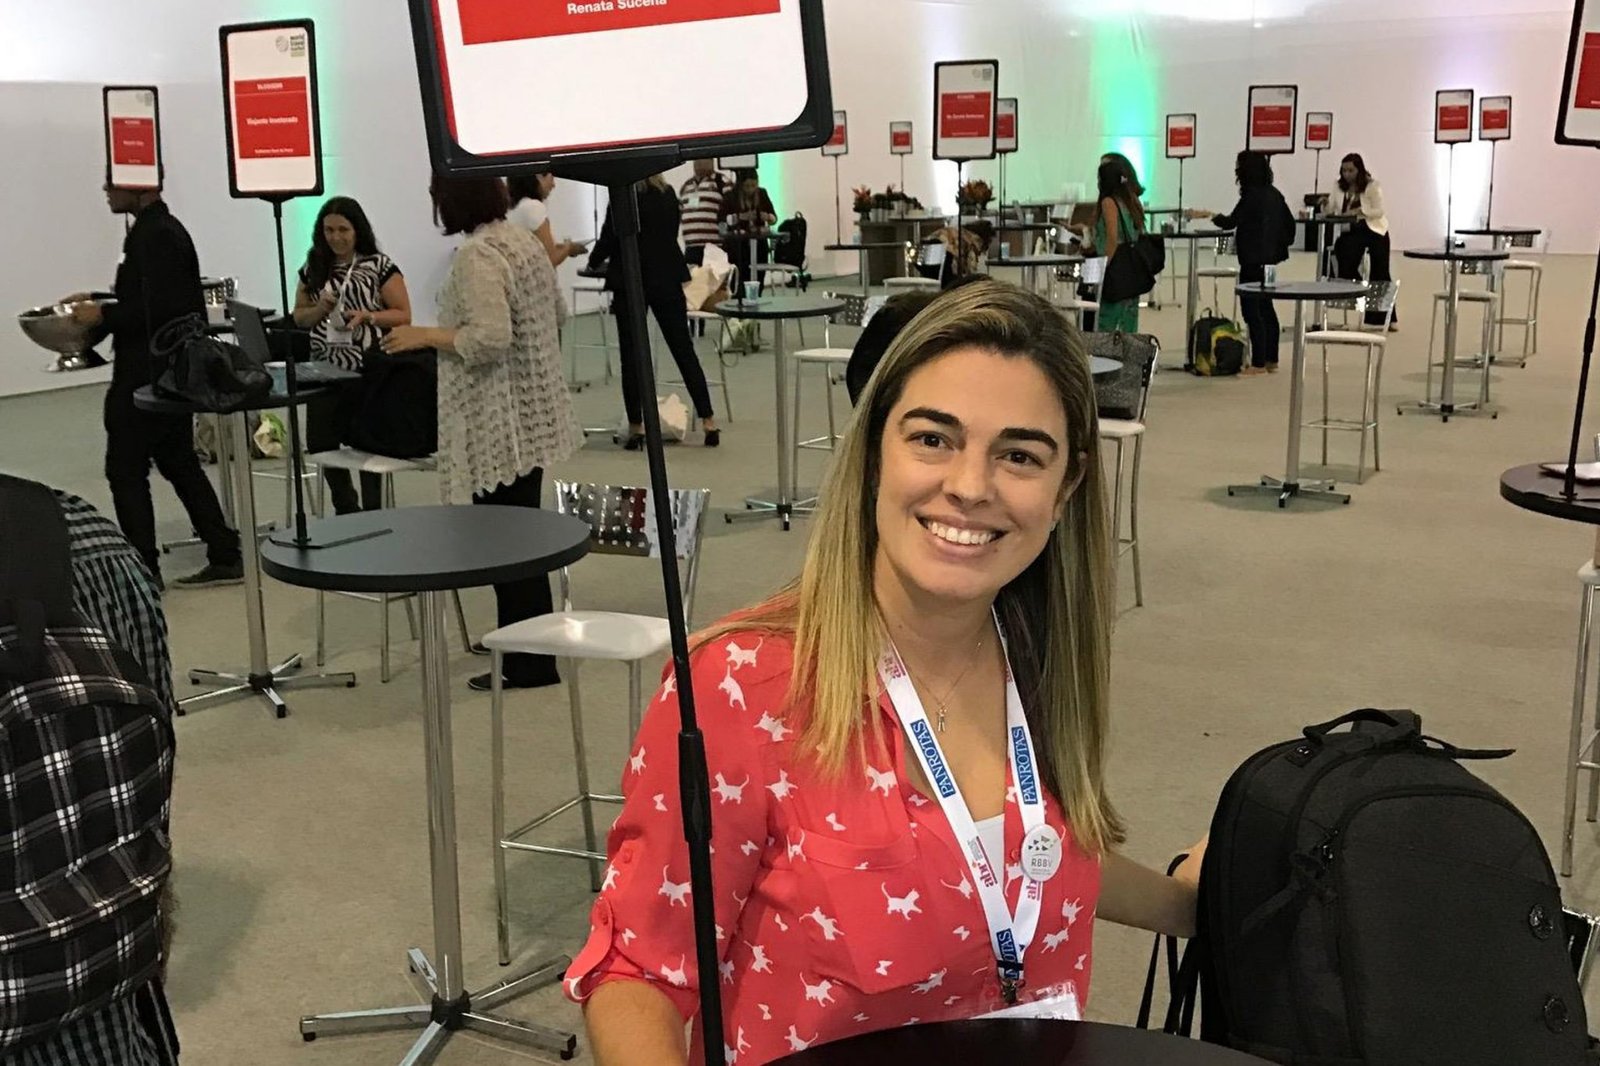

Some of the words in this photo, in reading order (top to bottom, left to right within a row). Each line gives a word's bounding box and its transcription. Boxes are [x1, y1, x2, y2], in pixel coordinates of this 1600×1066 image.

[567, 1, 614, 15] Renata
[912, 719, 954, 796] PANROTAS
[1013, 725, 1037, 803] PANROTAS
